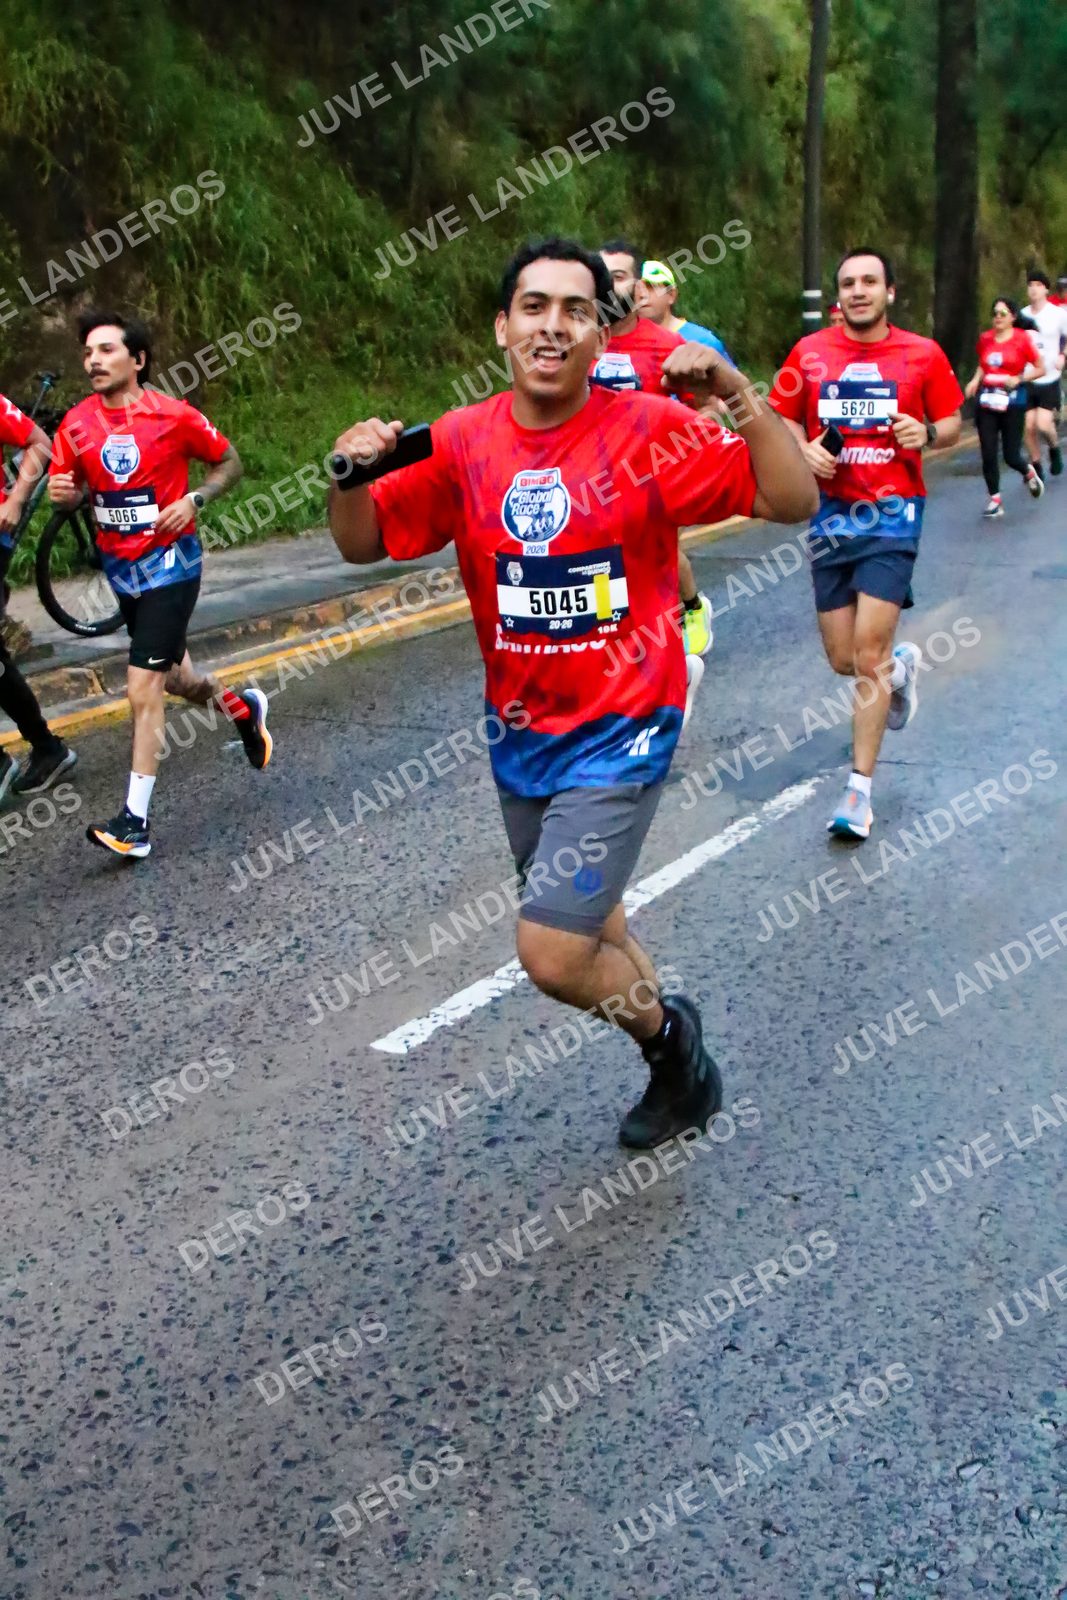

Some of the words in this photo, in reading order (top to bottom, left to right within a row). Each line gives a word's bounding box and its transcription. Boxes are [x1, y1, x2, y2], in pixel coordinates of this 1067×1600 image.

[841, 401, 875, 416] 5620
[837, 447, 896, 465] NTIAGO
[520, 475, 554, 487] BIMBO
[518, 488, 554, 504] Global
[108, 508, 138, 523] 5066
[511, 503, 540, 516] Race
[525, 544, 547, 555] 2026
[529, 588, 589, 616] 5045
[597, 623, 618, 634] 10K
